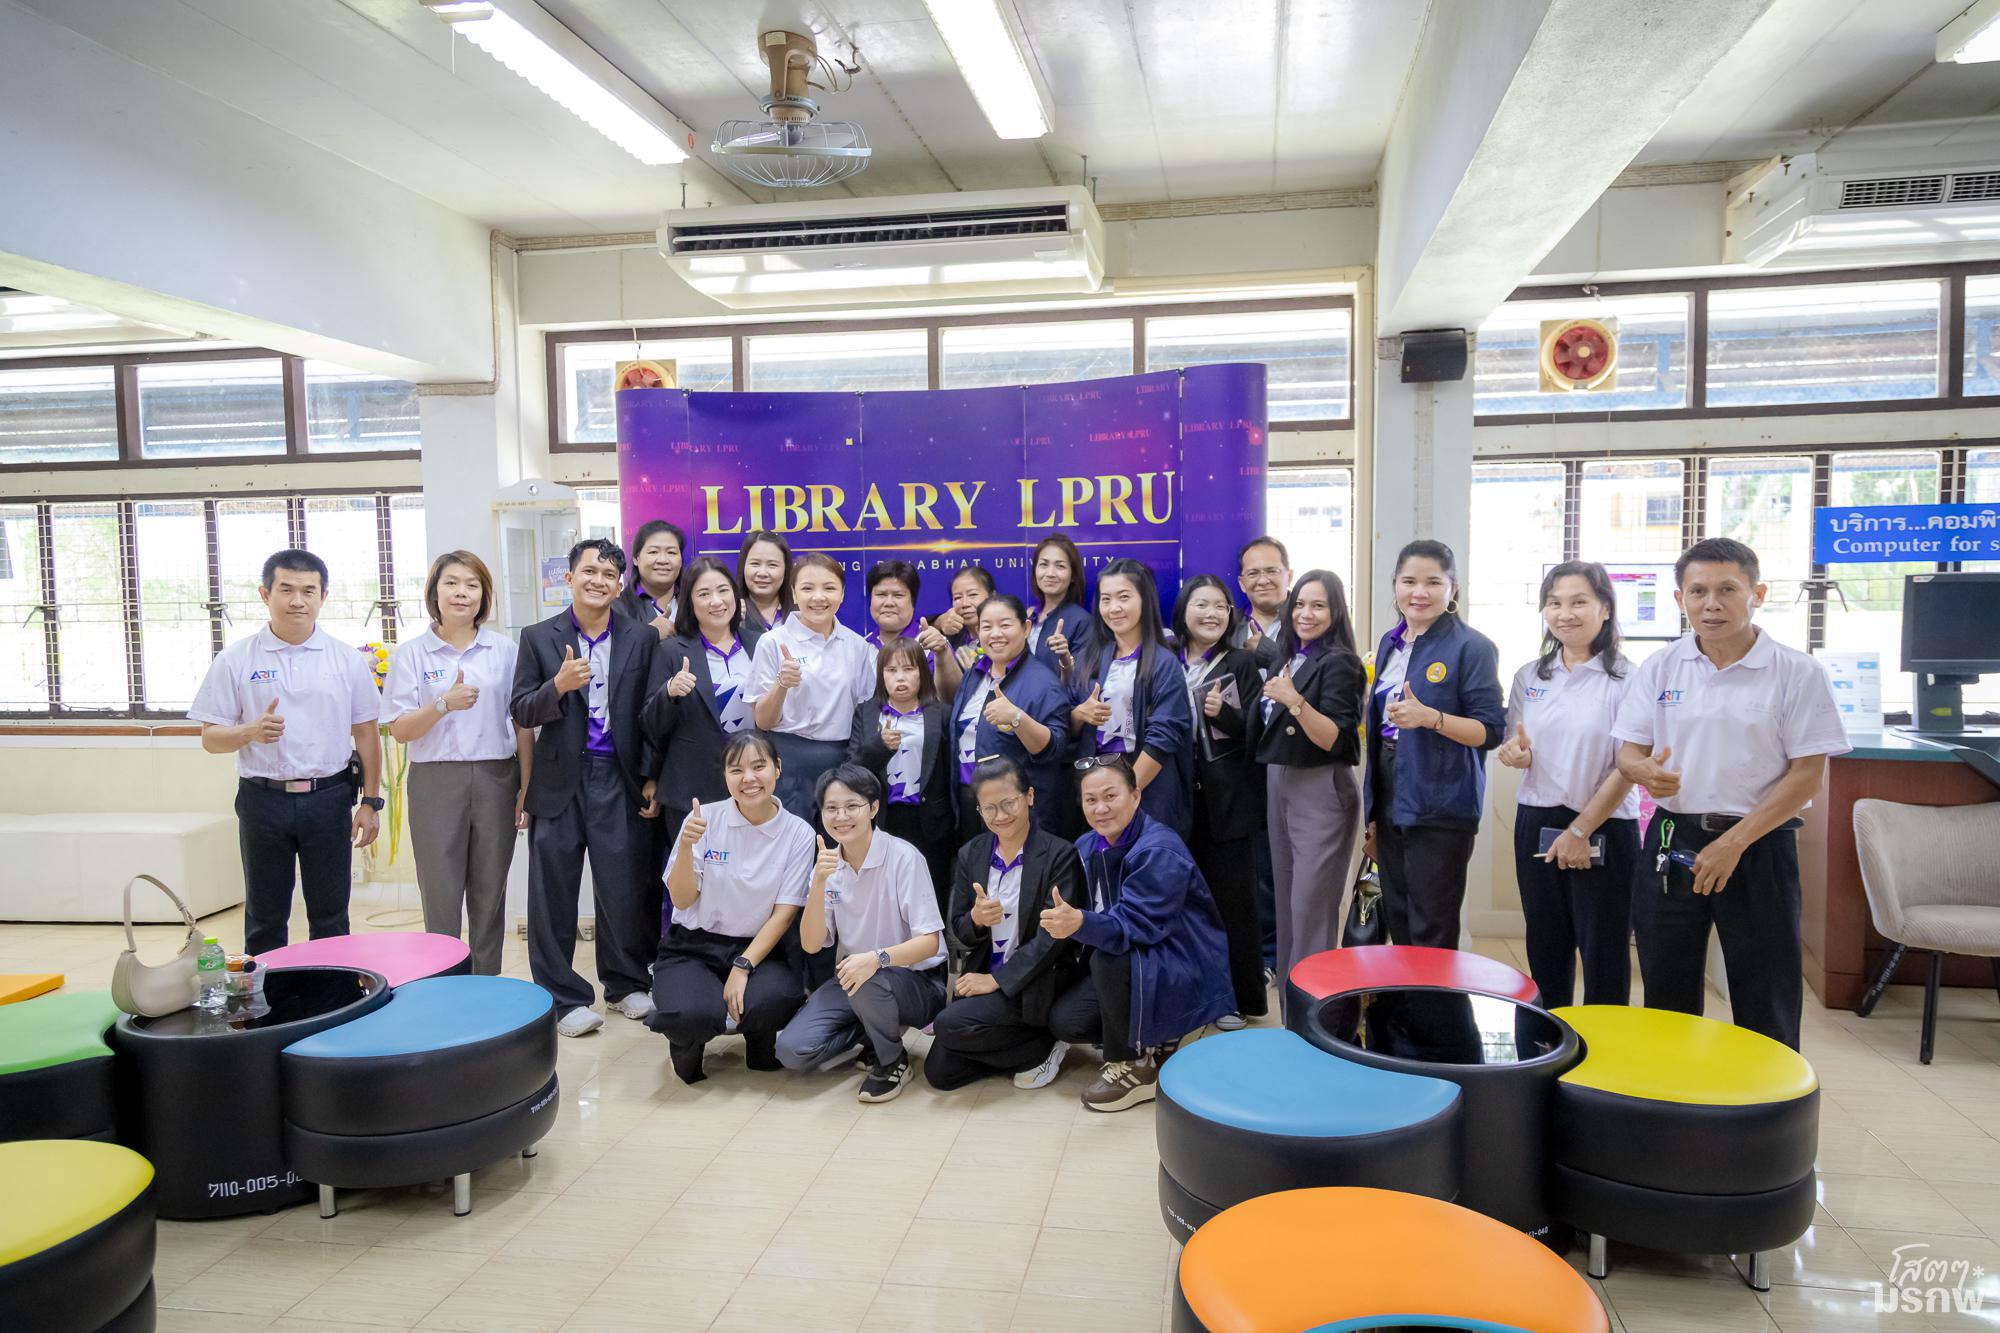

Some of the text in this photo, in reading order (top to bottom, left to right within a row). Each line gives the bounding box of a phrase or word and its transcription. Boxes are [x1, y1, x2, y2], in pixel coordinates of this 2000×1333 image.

[700, 471, 1176, 534] LIBRARY LPRU
[1830, 509, 2000, 533] บริการ...คอมพิ
[1833, 537, 1941, 557] Computer
[1951, 535, 1981, 551] for
[250, 670, 278, 681] ARIT
[423, 669, 446, 681] ARIT
[703, 849, 730, 862] ARIT
